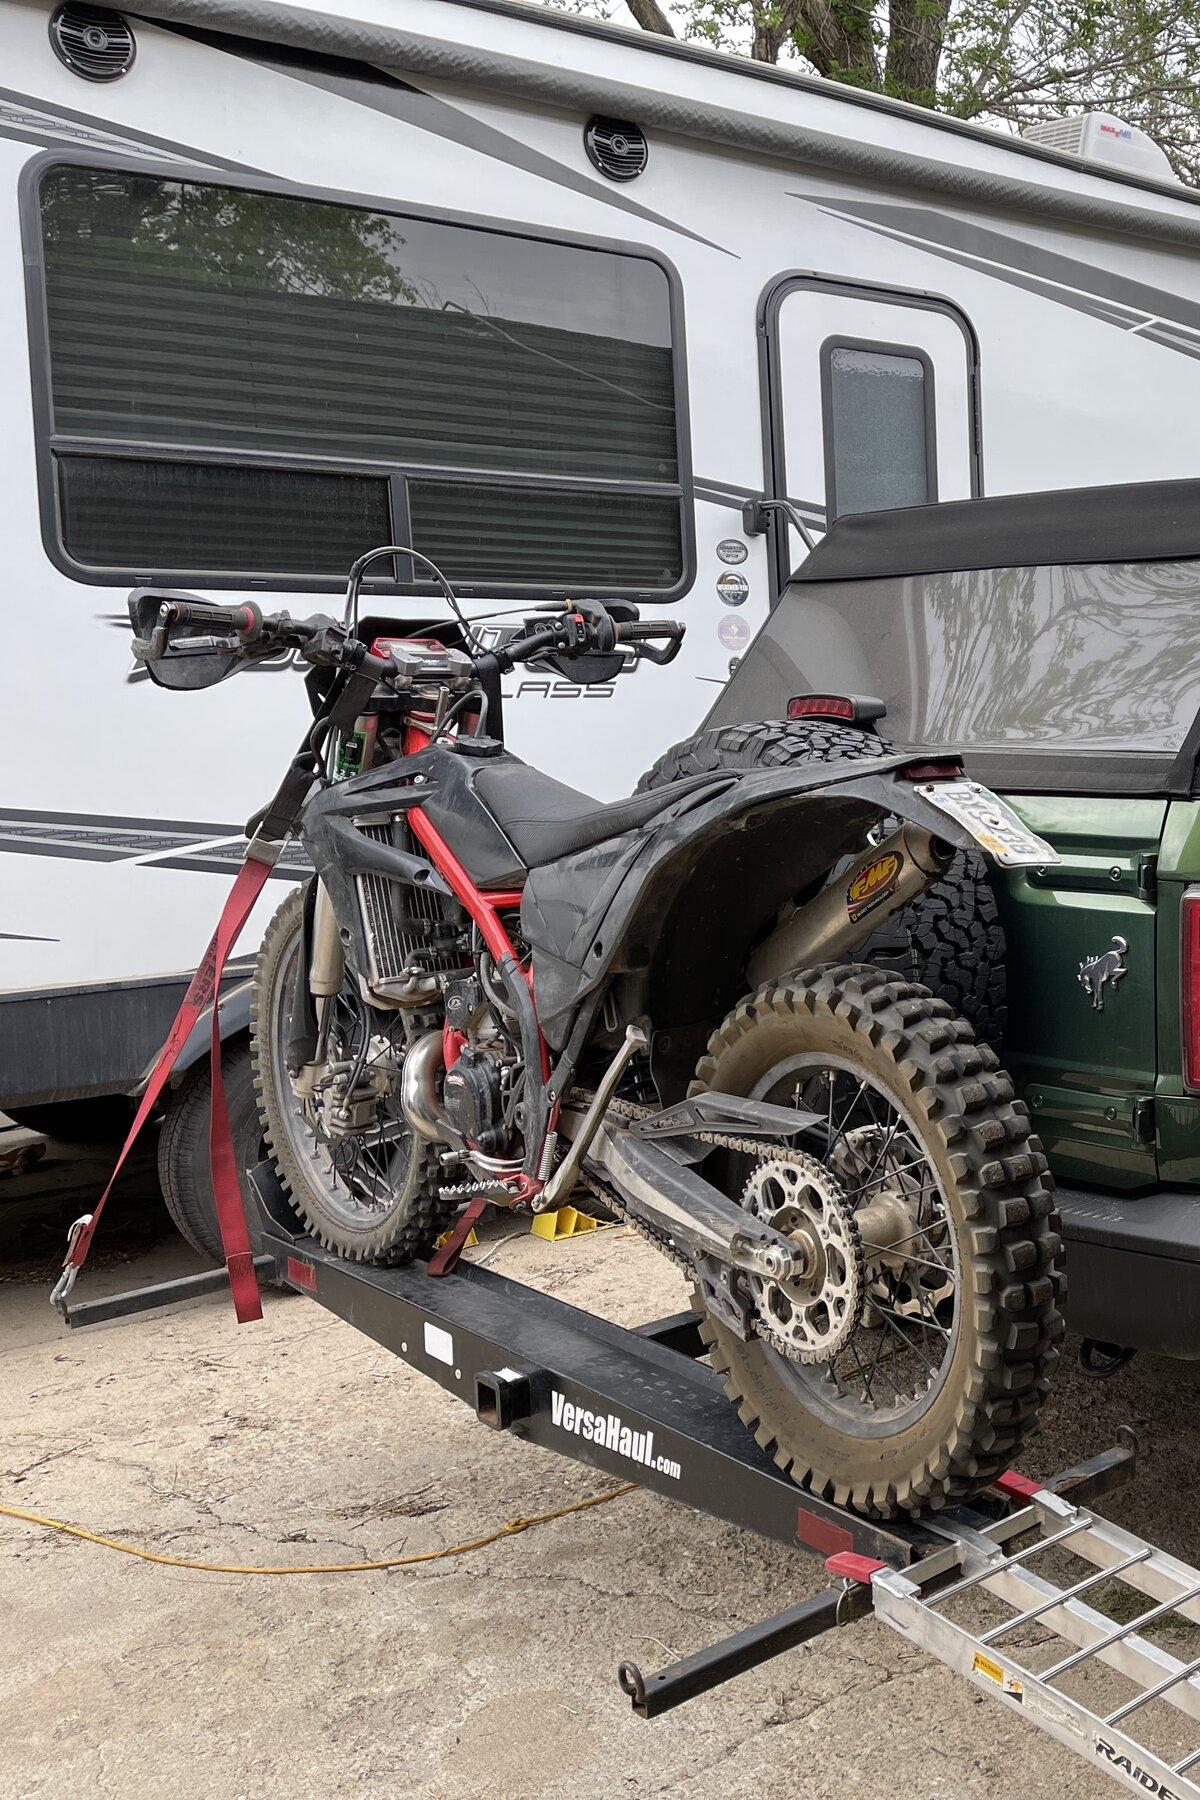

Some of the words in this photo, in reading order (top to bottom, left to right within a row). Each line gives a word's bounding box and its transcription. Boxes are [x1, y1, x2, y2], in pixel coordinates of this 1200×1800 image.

[850, 854, 895, 901] FMF
[551, 1390, 682, 1480] VersaHaul.com
[1096, 1737, 1181, 1800] RAIDE
